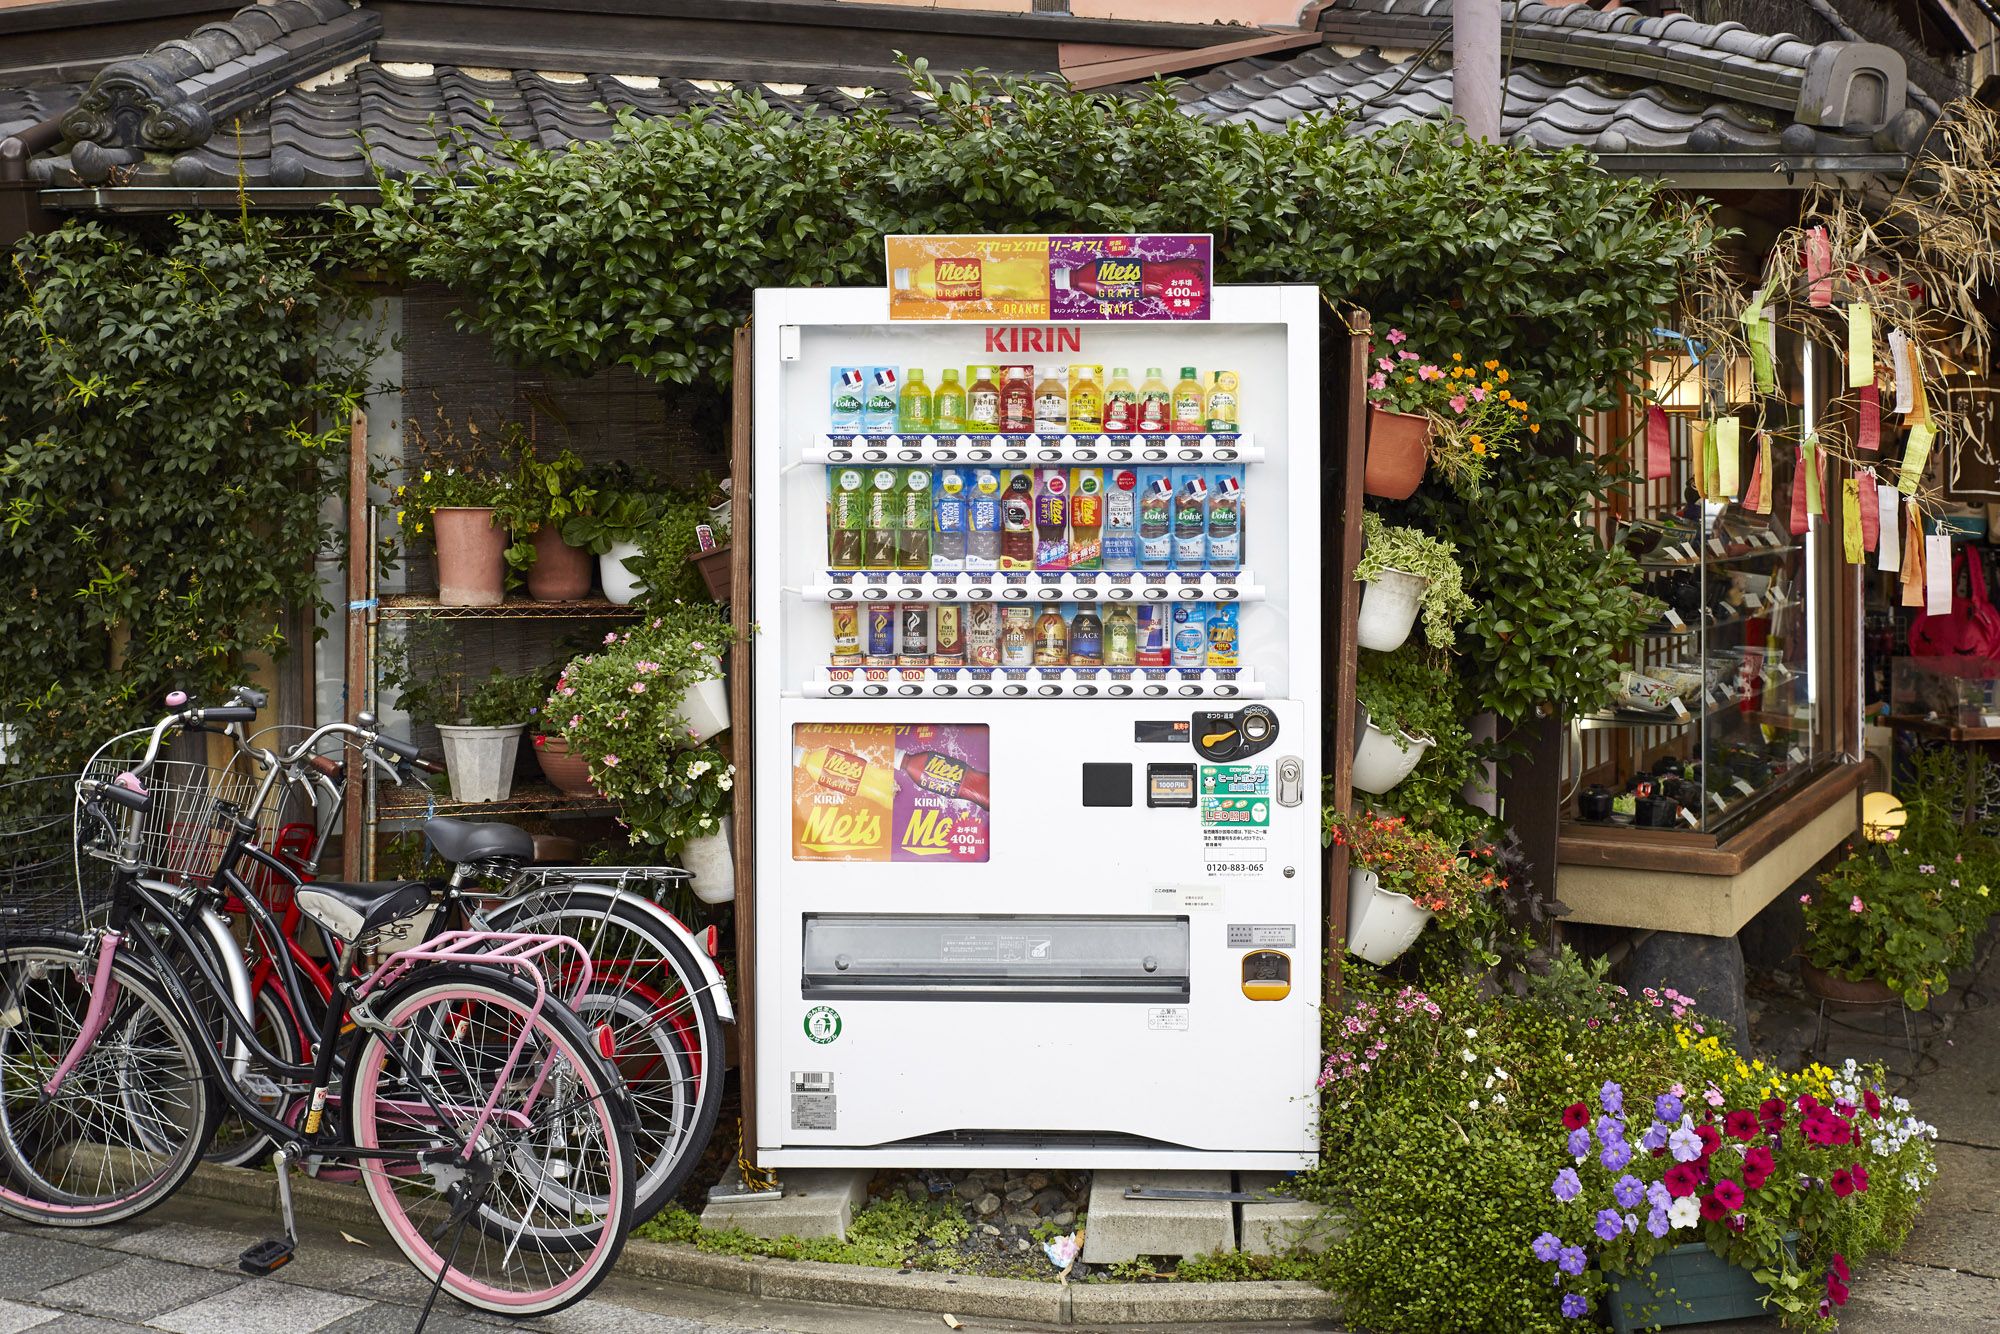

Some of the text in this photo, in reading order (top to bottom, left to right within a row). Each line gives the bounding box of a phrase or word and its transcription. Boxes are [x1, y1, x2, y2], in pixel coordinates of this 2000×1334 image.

[936, 263, 980, 280] Mets
[1098, 263, 1140, 281] Mets
[937, 289, 980, 297] ORANGE
[1098, 289, 1140, 298] GRAPE
[1165, 288, 1200, 297] 400ml
[1004, 304, 1046, 314] ORANGE
[1100, 304, 1134, 314] GRAPE
[986, 327, 1080, 352] KIRIN
[834, 399, 859, 408] Volvic
[868, 399, 892, 408] Volvic
[1052, 498, 1063, 524] Mets
[824, 754, 862, 777] Mets
[925, 757, 963, 781] Mets
[819, 776, 857, 794] ORANGE
[921, 778, 956, 796] GRAPE
[814, 795, 844, 804] KIRIN
[915, 798, 944, 806] KIRIN
[1206, 811, 1250, 822] LED照明
[801, 807, 881, 844] Mets
[950, 834, 984, 844] 400ml
[809, 1034, 837, 1044] リサイクル
